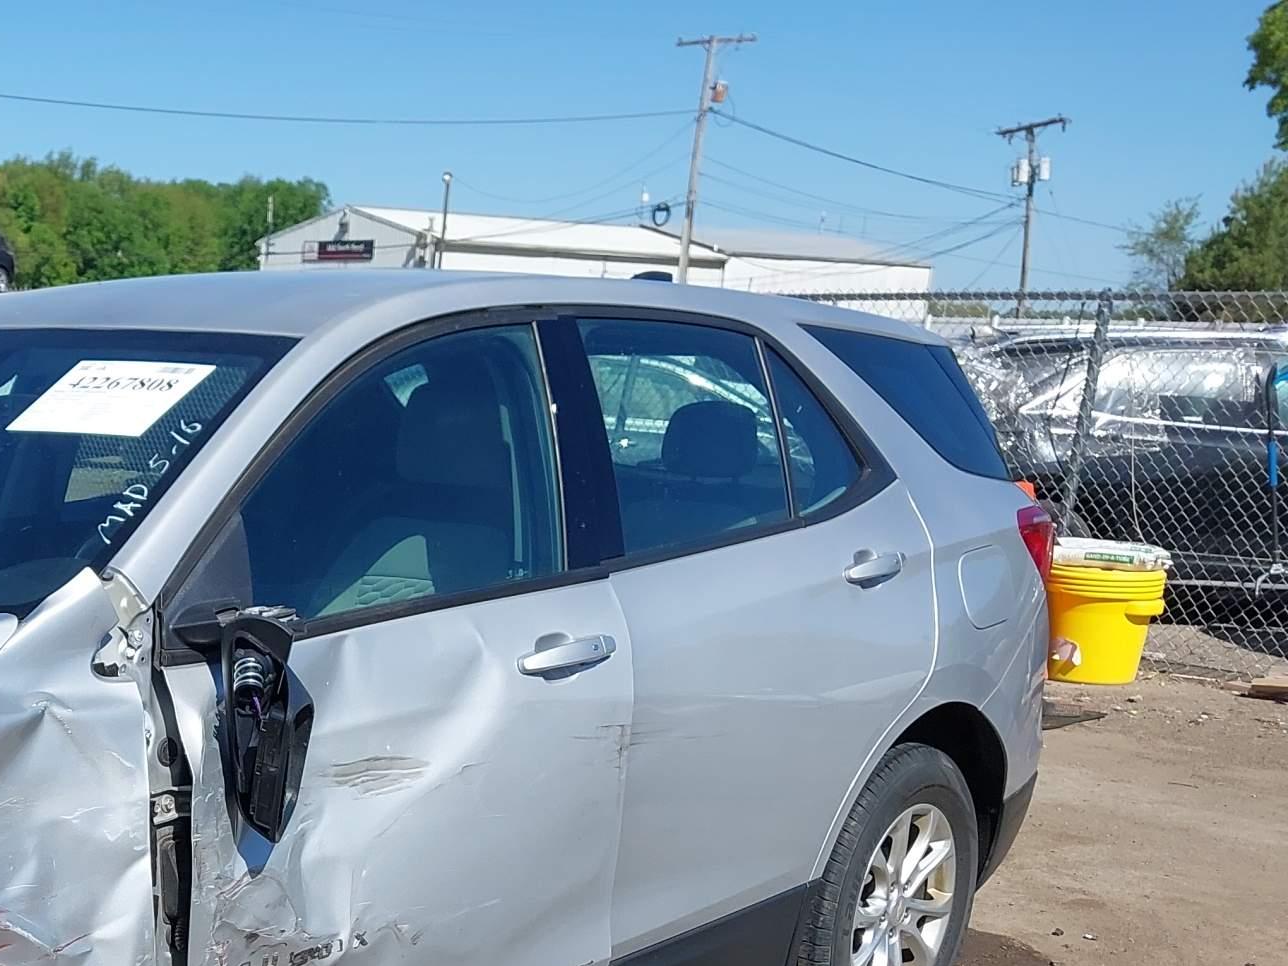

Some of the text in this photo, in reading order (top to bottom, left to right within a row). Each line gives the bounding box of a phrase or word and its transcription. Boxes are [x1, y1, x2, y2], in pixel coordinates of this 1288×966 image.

[70, 375, 180, 392] 42267808
[97, 418, 202, 545] MAD 5-16
